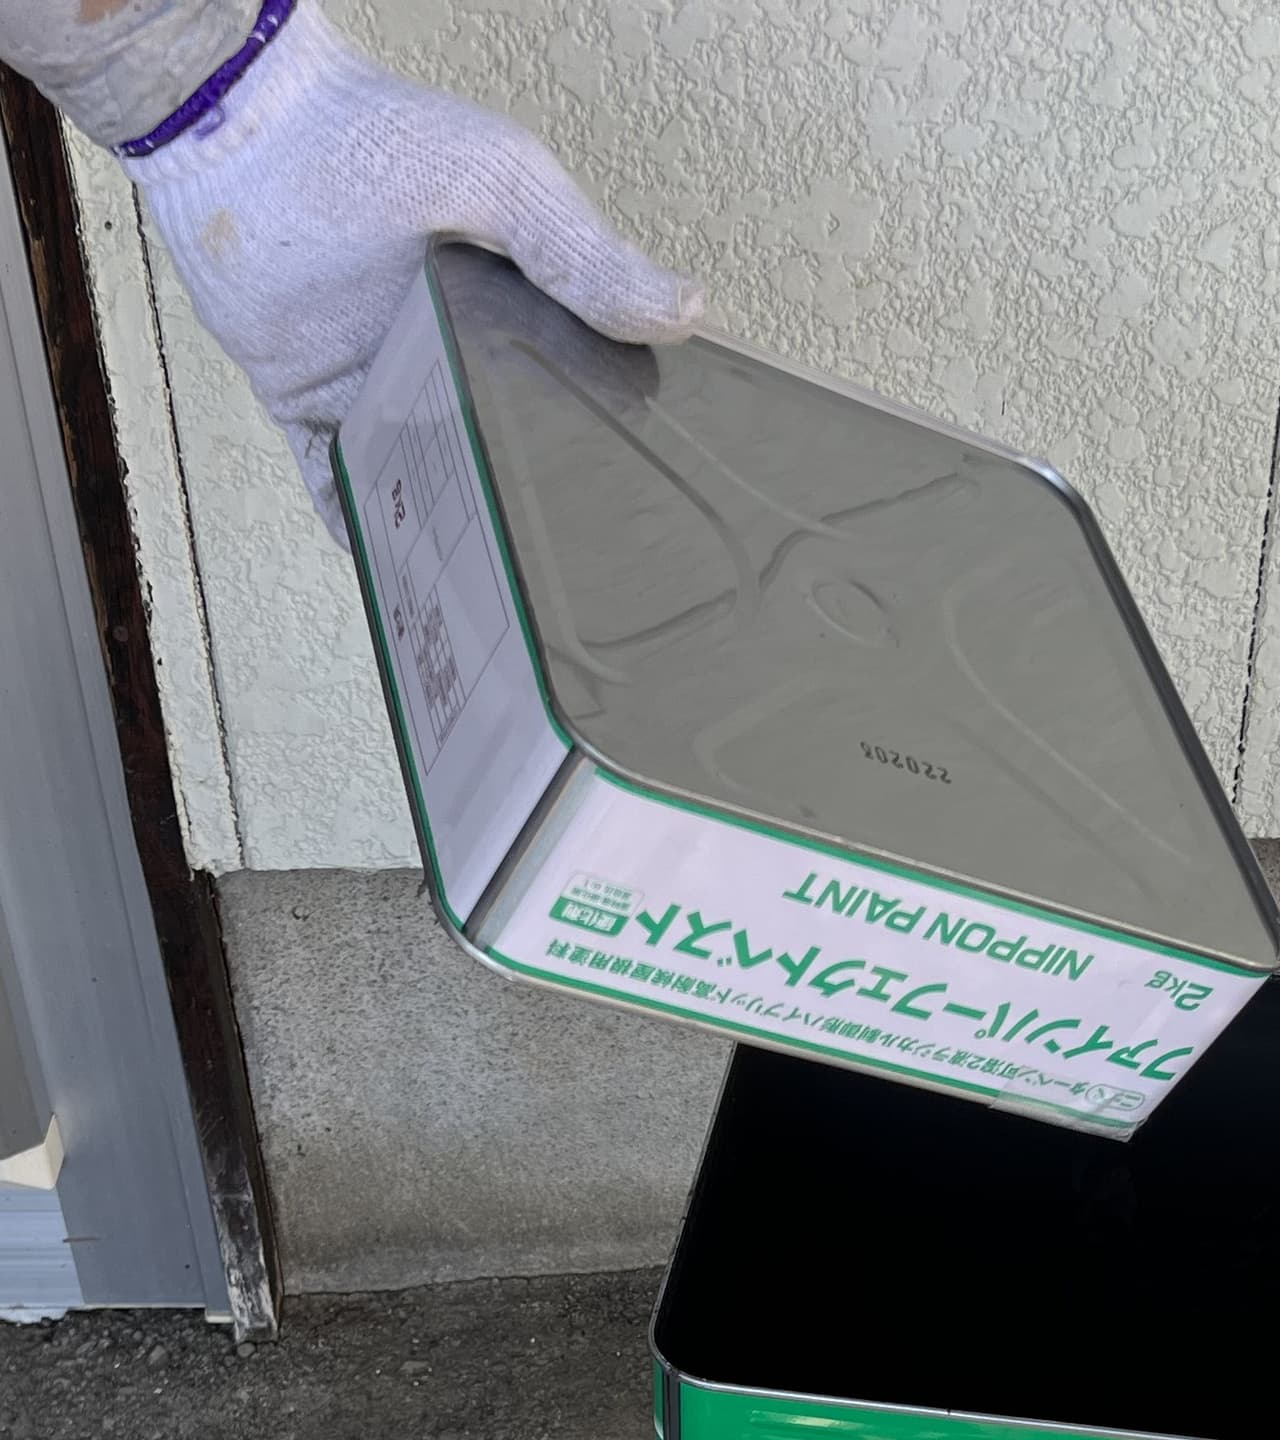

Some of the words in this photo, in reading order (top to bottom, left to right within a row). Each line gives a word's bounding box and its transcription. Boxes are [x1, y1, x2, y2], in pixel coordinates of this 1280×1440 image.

[782, 872, 927, 934] PAINT
[923, 911, 1096, 980] NIPPON
[636, 904, 1196, 1083] ファインパーフェクトベスト
[1144, 970, 1214, 1012] 2kg
